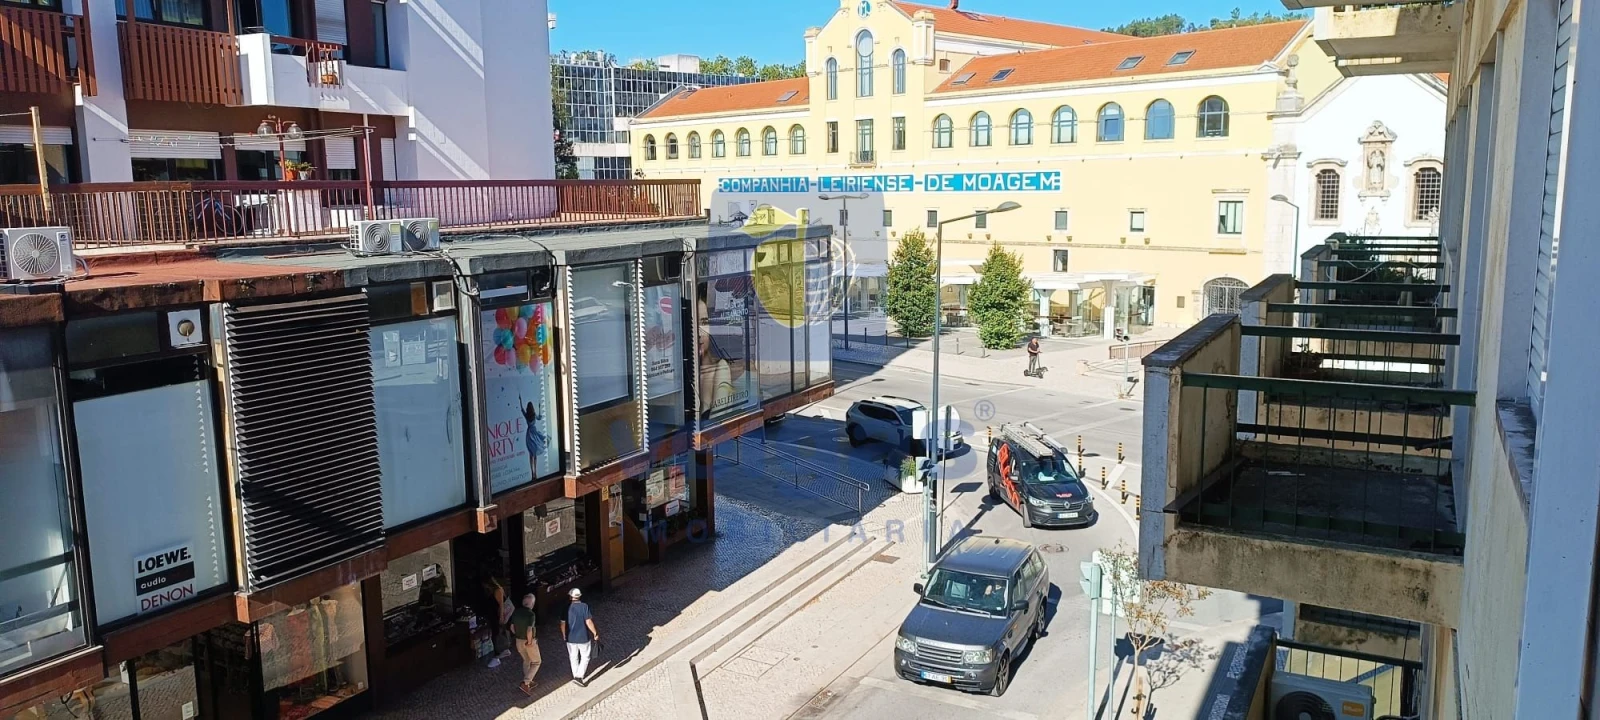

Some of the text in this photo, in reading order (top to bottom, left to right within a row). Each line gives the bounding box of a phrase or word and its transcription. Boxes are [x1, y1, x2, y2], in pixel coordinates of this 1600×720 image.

[721, 177, 808, 193] COMPANHIA
[820, 174, 911, 193] LEIRIENSE
[927, 174, 955, 191] DE
[962, 172, 1055, 191] MOAGEM
[137, 546, 192, 574] LOEWE.
[140, 576, 167, 589] audio
[140, 583, 194, 612] DENON
